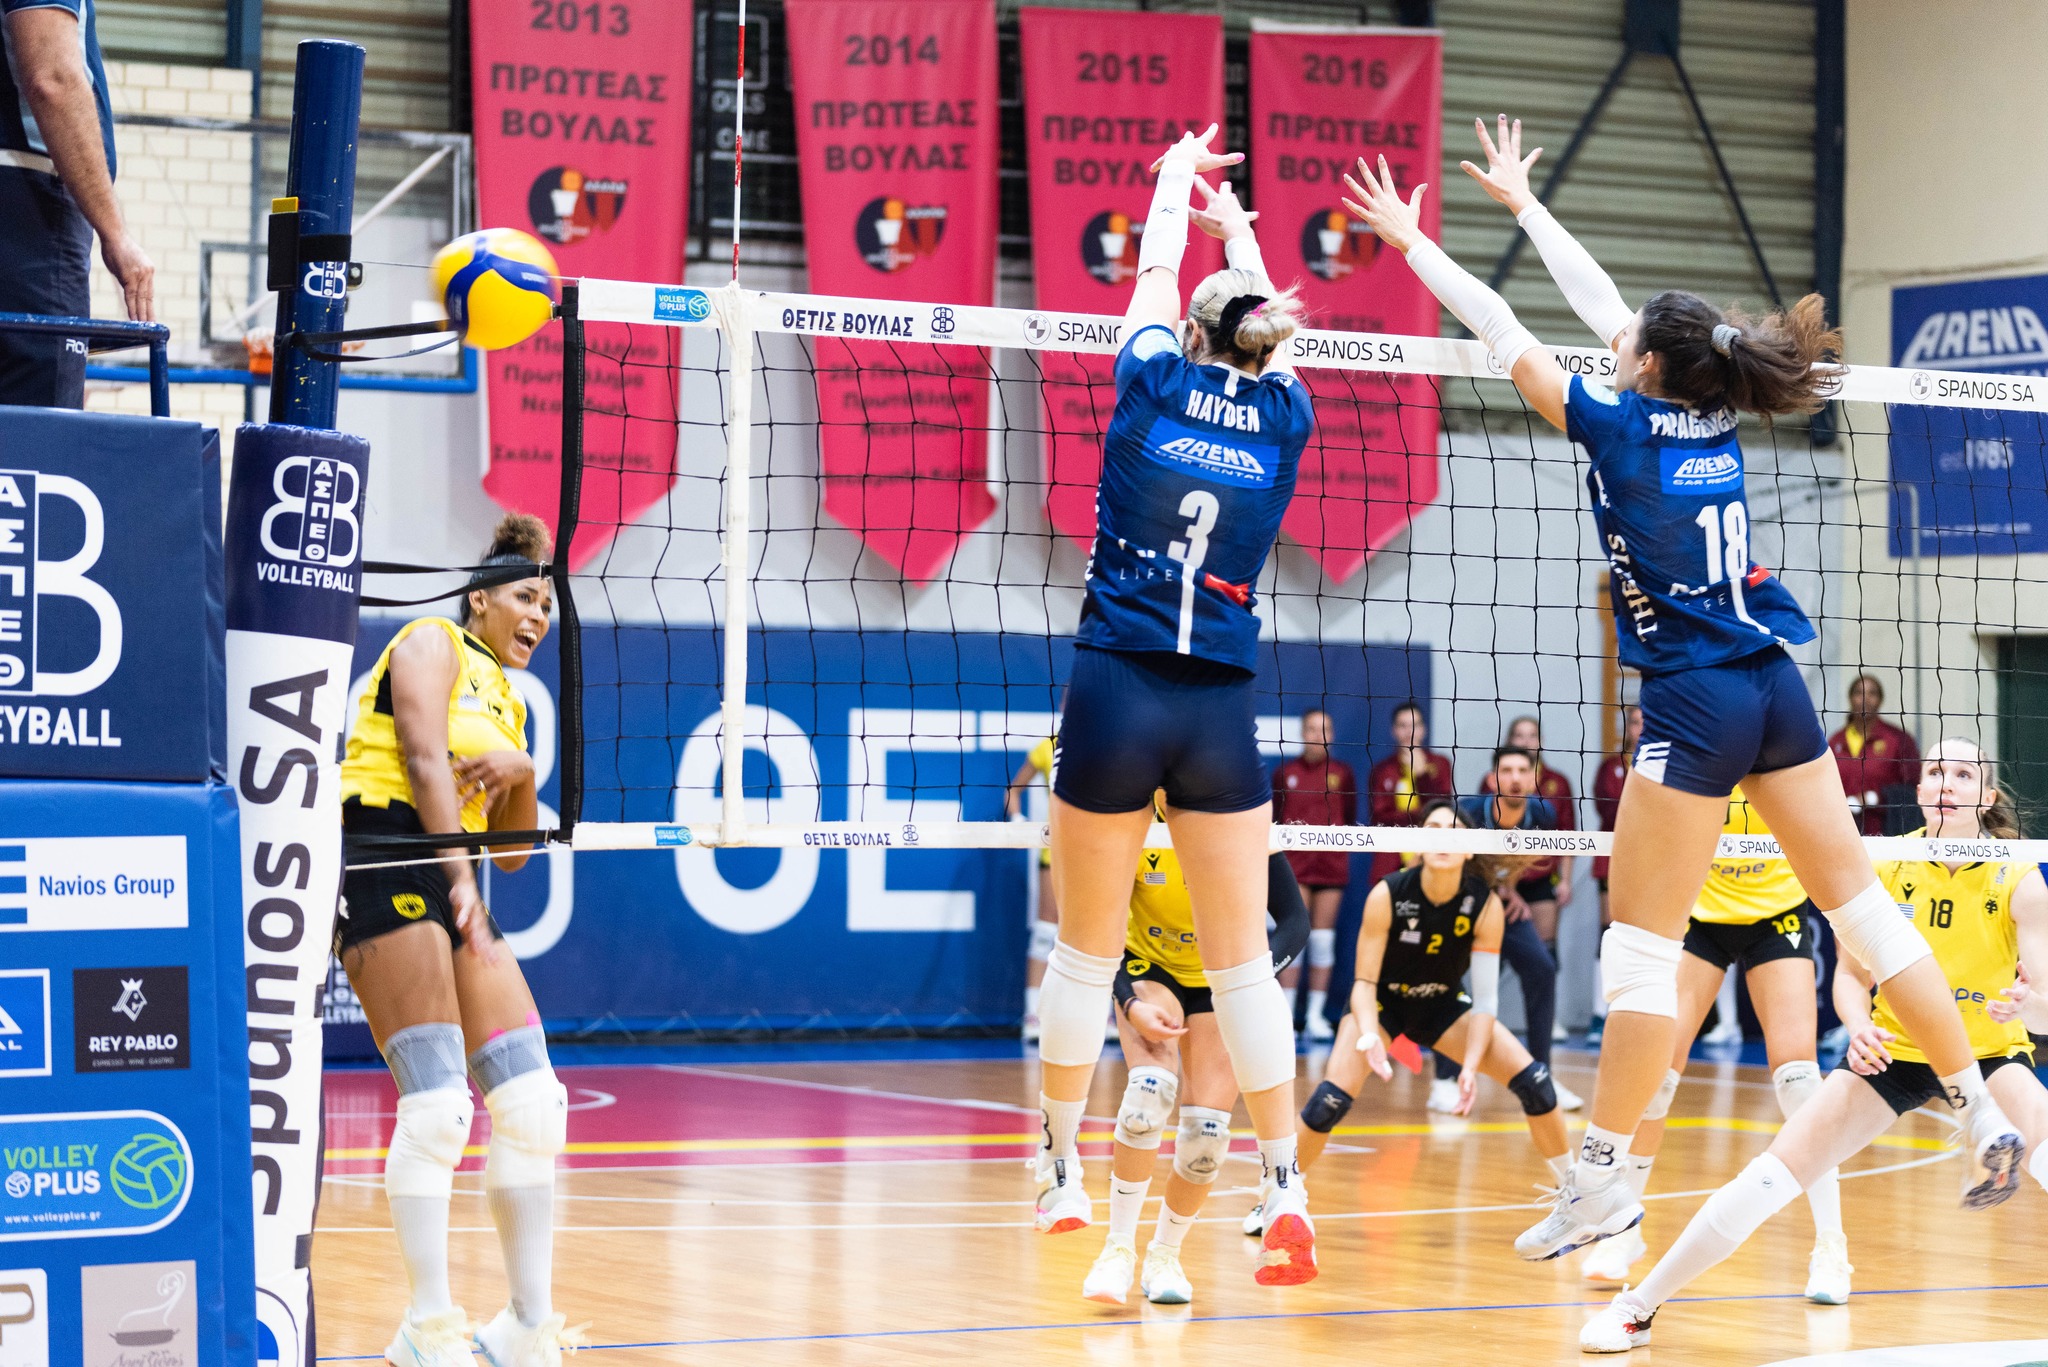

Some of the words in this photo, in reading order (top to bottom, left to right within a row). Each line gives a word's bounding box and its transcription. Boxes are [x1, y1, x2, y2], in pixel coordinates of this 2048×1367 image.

[530, 0, 630, 36] 2013
[845, 34, 940, 66] 2014
[490, 62, 668, 103] ΠΡΩΤΕΑΣ
[1077, 52, 1169, 85] 2015
[1303, 53, 1389, 90] 2016
[501, 108, 656, 147] ΒΟΥΛΑΣ
[811, 100, 976, 128] ΠΡΩΤΕΑΣ
[1268, 111, 1421, 150] ΠΡΩΤΕΑΣ
[824, 143, 969, 172] ΒΟΥΛΑΣ
[1054, 158, 1159, 187] ΒΟΥΛ
[1277, 154, 1409, 190] ΒΟΥΣ
[323, 261, 335, 296] ΣΠΕΘ
[659, 294, 686, 303] VOLLEY
[667, 302, 687, 311] PLUS
[782, 308, 837, 331] ΘΕΤΙΣ
[842, 312, 914, 337] ΒΟΥΛΑΣ
[1901, 305, 2048, 366] ARENA
[1293, 337, 1374, 361] SPANOS
[1378, 342, 1404, 363] SA
[1555, 354, 1594, 375] NOS
[1937, 378, 2008, 402] SPANOS
[2012, 383, 2035, 402] SA
[1184, 388, 1260, 433] HAYDEN
[1158, 437, 1265, 474] ARENA
[1672, 452, 1739, 478] ARENA
[1198, 463, 1264, 482] RENTAL
[1166, 489, 1220, 570] 3
[1695, 500, 1748, 585] 18
[256, 561, 354, 593] VOLLEYBALL
[0, 706, 122, 747] YBALL
[239, 668, 329, 809] SA
[803, 832, 840, 846] ΘΕΤΙΣ
[843, 833, 892, 847] ΒΟΥΛΑΣ
[1299, 832, 1354, 847] SPANOS
[1356, 833, 1375, 847] SA
[1524, 836, 1576, 851] SPANOS
[1579, 837, 1596, 851] SA
[1739, 840, 1784, 854] SPANO
[1944, 844, 1992, 858] SPANOS
[1995, 845, 2010, 858] SA
[39, 874, 107, 896] Navios
[113, 873, 175, 899] Group
[1771, 913, 1801, 935] 10
[1928, 897, 1954, 929] 18
[1147, 925, 1198, 943] esc
[1425, 933, 1443, 955] 2
[88, 1035, 122, 1053] REY
[124, 1033, 179, 1052] PABLO
[128, 1058, 145, 1066] WINE
[4, 1143, 99, 1170] VOLLEY
[34, 1169, 101, 1197] PLUS
[4, 1210, 102, 1224] www.volleyplus.gr
